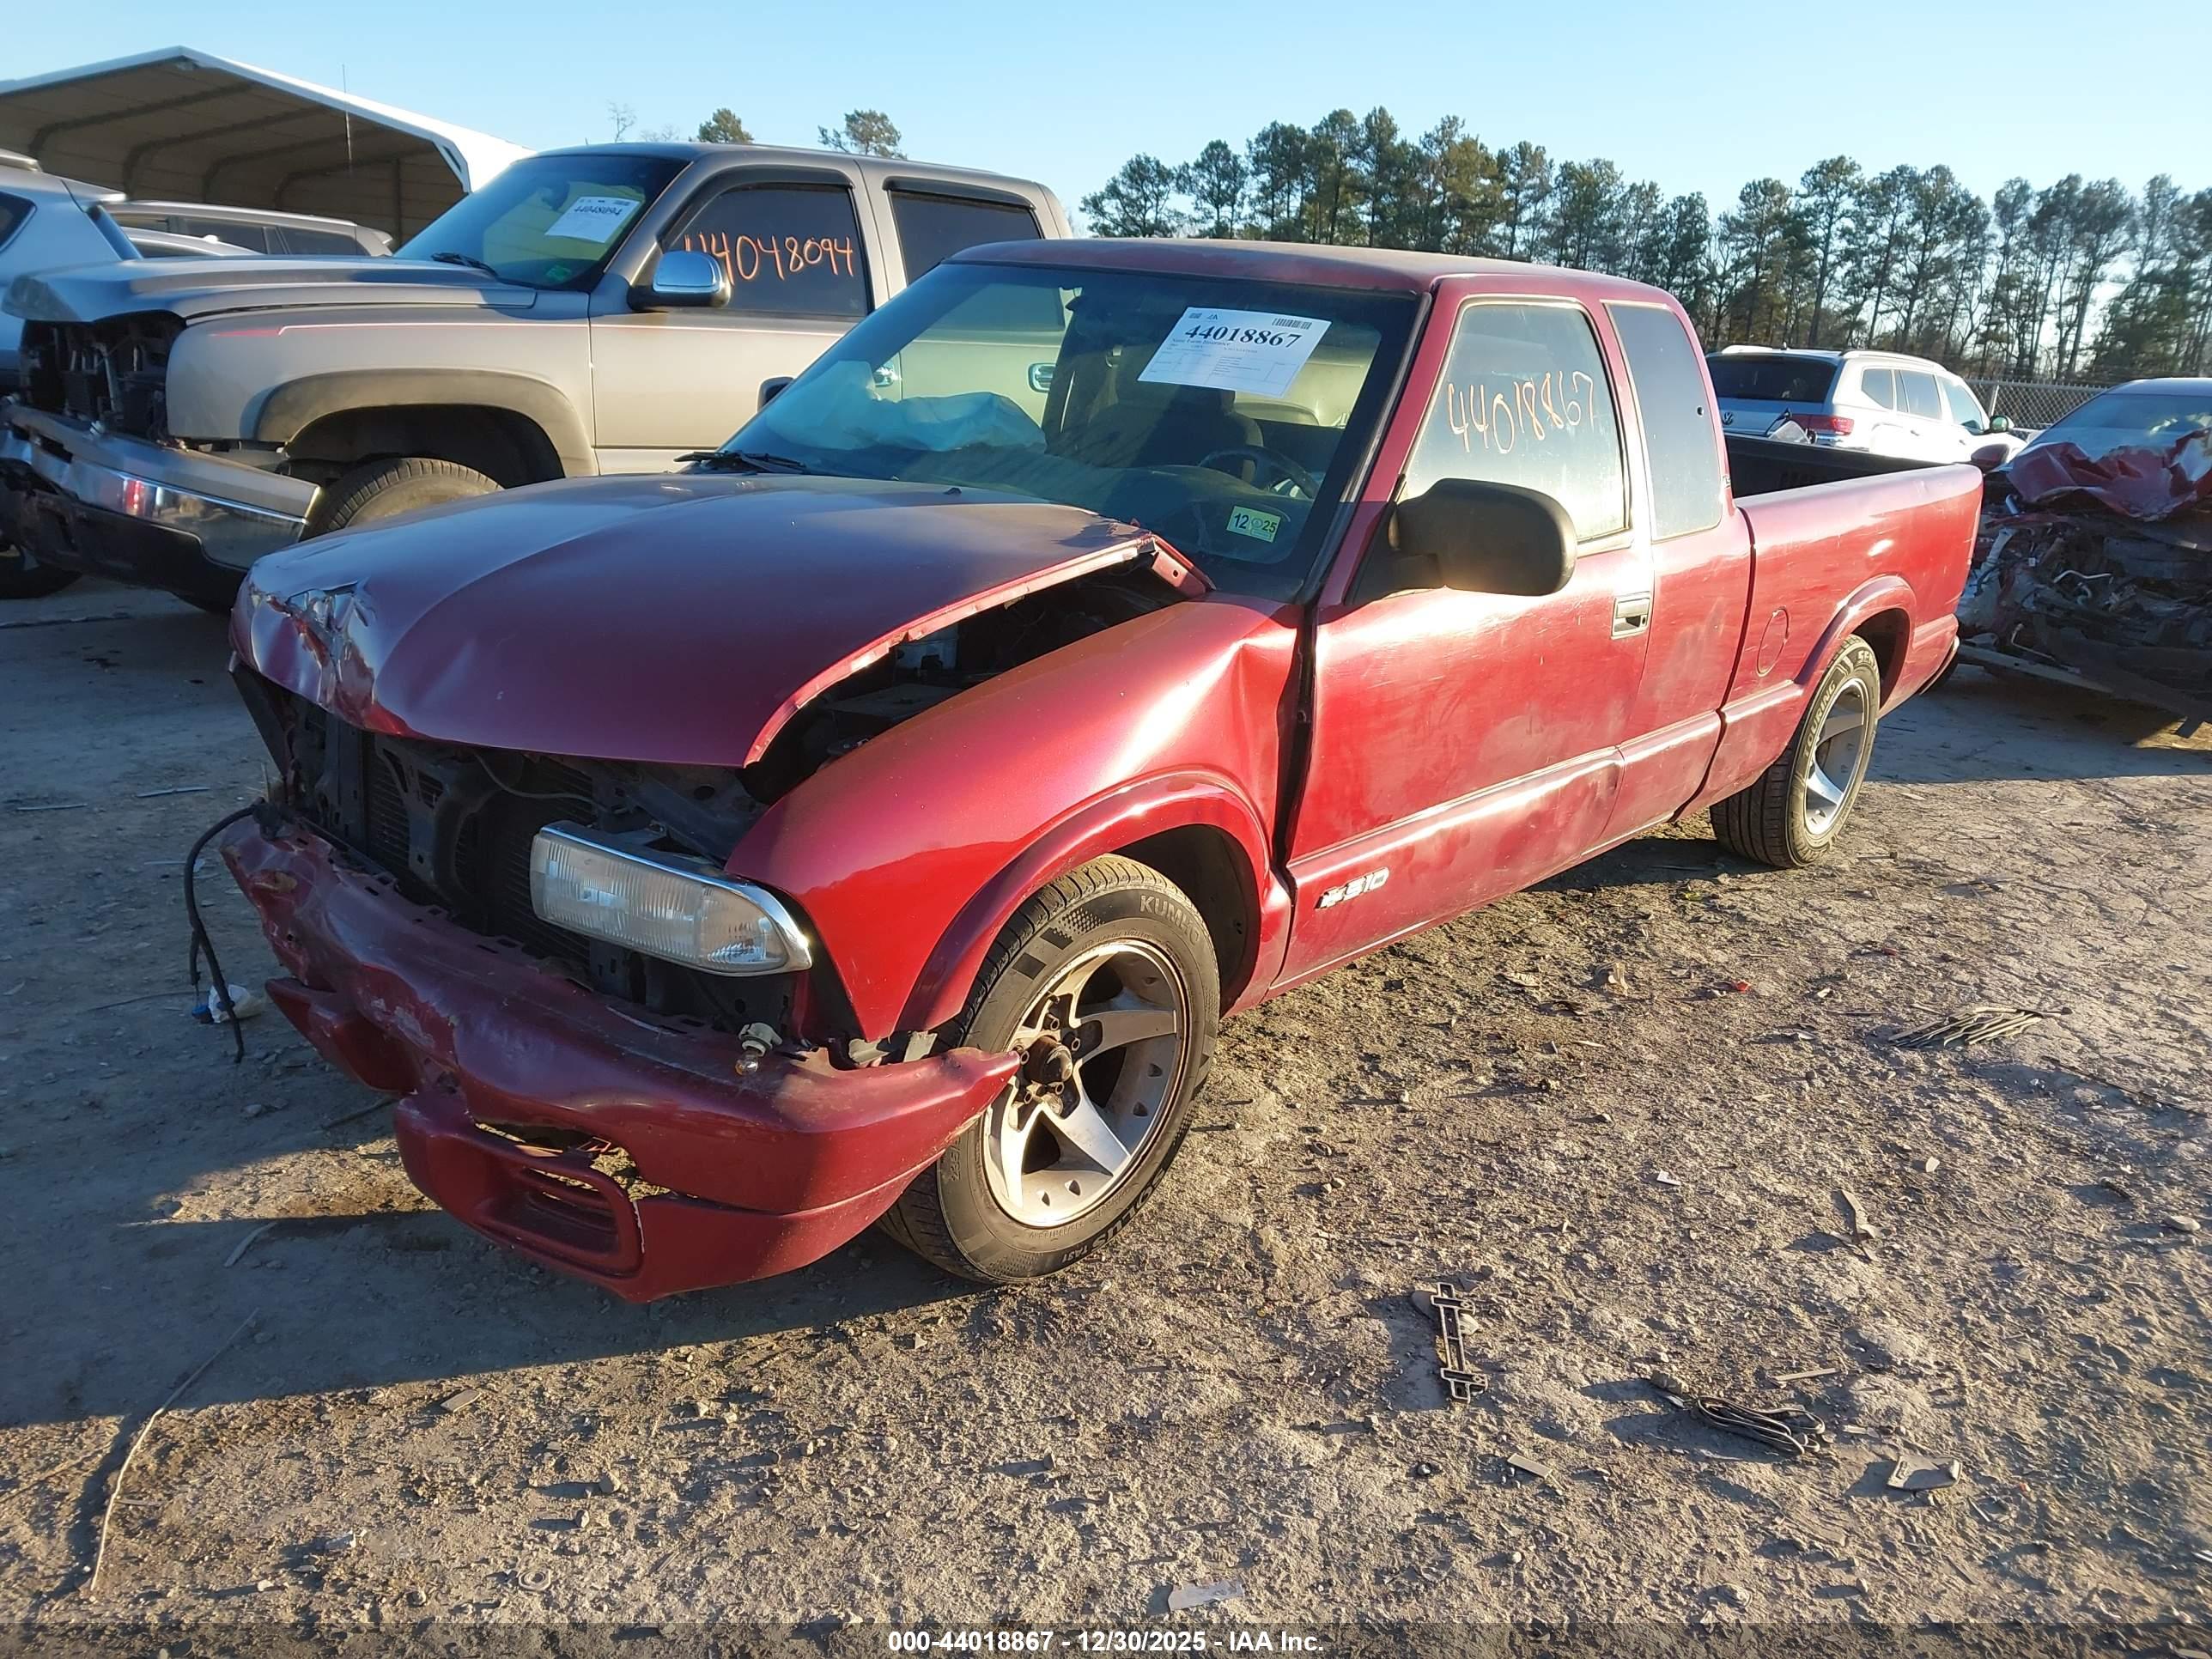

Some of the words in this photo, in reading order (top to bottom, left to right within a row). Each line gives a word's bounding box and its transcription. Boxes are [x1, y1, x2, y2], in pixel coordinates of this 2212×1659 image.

[1185, 325, 1303, 348] 44018867
[1448, 370, 1595, 453] 44018867
[1234, 513, 1249, 529] 12
[1262, 520, 1278, 533] 25
[1804, 679, 1836, 757] TOURING
[1139, 895, 1201, 945] KUMHO
[1091, 1168, 1165, 1253] SOLUS
